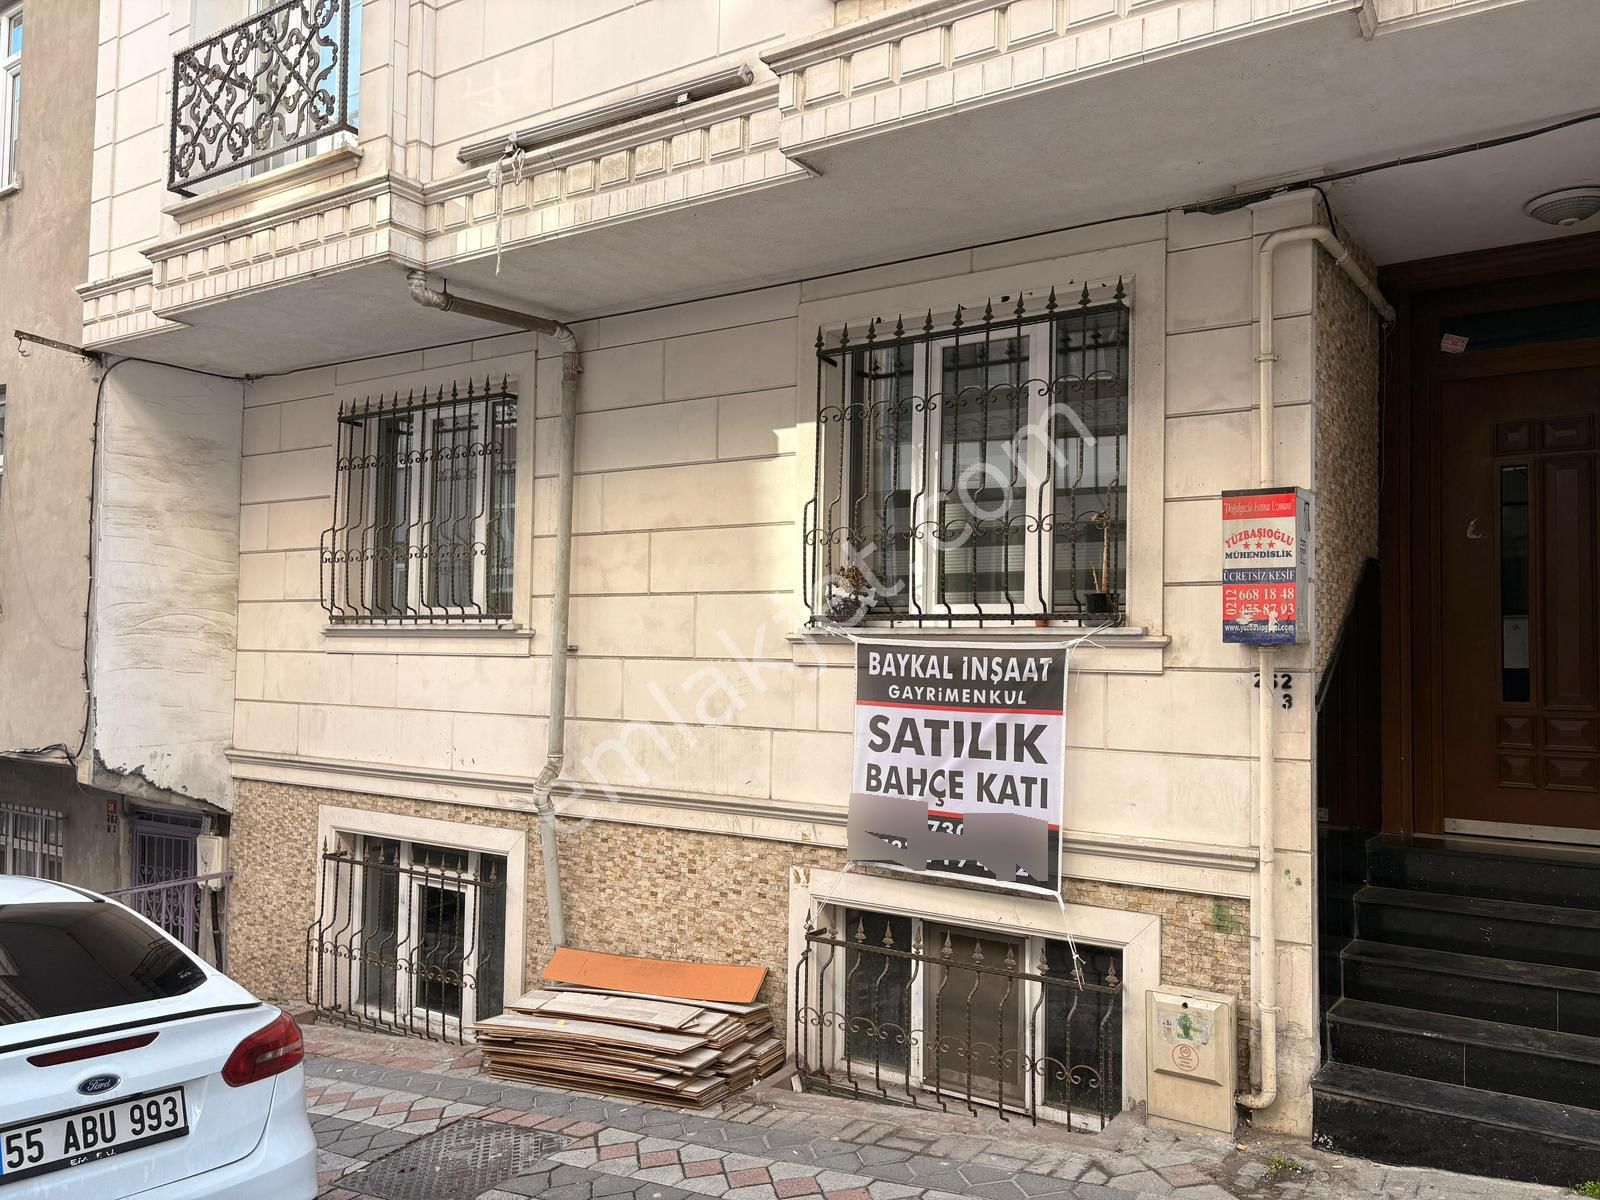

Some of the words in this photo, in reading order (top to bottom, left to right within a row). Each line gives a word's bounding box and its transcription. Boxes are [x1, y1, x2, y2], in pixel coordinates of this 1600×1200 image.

[1224, 527, 1294, 549] YÜZBAŞIOĞLU
[1225, 548, 1293, 560] MÜHENDİSLİK
[1223, 570, 1267, 582] ÜCRETSİZ
[1269, 568, 1296, 582] KEŞİF
[1225, 589, 1237, 615] 0212
[1238, 588, 1260, 600] 668
[1263, 588, 1277, 600] 18
[1280, 587, 1295, 600] 48
[1280, 603, 1295, 615] 93
[868, 652, 954, 680] BAYKAL
[962, 656, 1053, 685] İNŞAAT
[868, 714, 1048, 765] SATILIK
[865, 762, 964, 807] BAHÇE
[976, 772, 1048, 809] KATI
[86, 1078, 113, 1093] Ford
[5, 1128, 44, 1169] 55
[63, 1110, 117, 1155] ABU
[130, 1096, 179, 1136] 993
